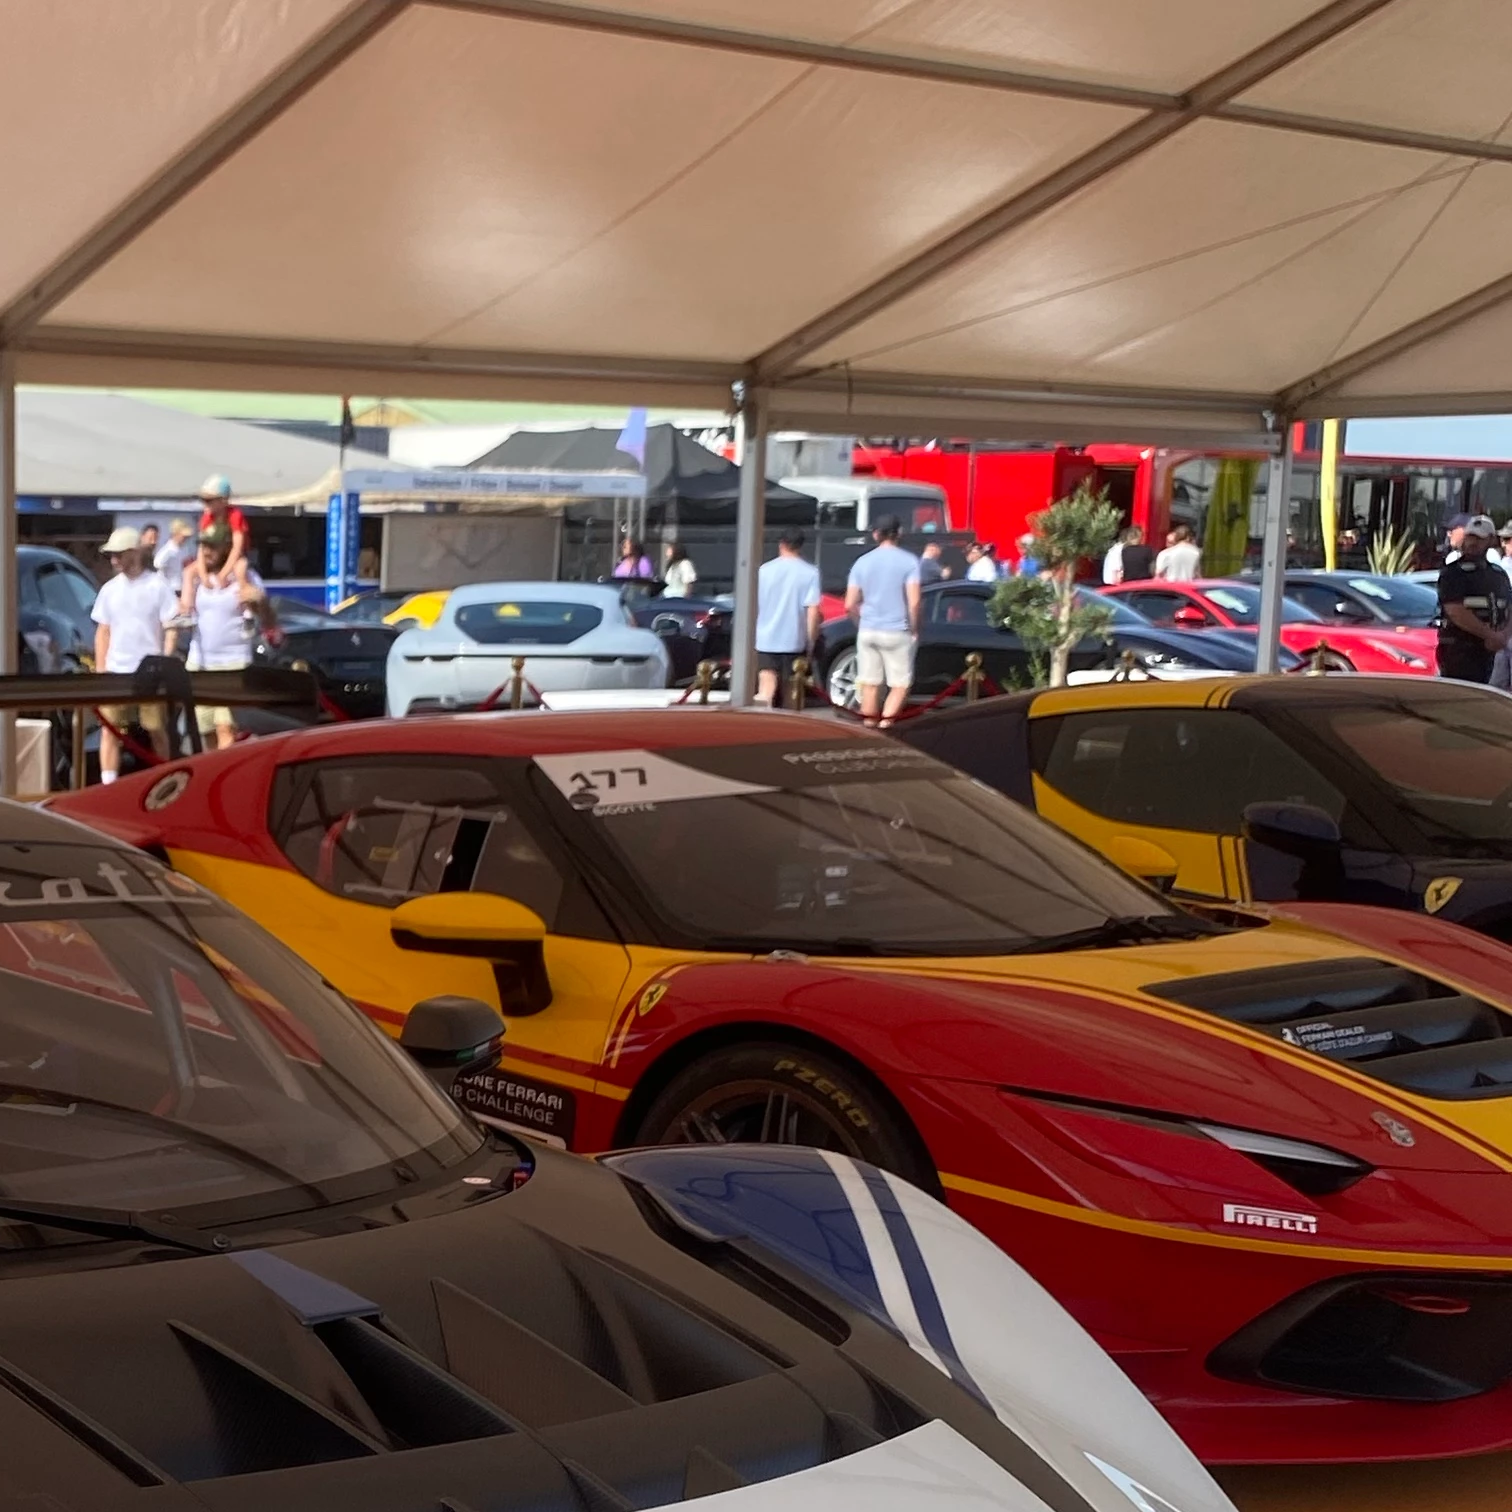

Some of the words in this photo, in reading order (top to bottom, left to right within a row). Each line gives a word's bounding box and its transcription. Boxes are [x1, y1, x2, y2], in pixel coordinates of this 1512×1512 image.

[570, 768, 648, 792] 177
[466, 1088, 554, 1125] CHALLENGE
[497, 1080, 563, 1110] FERRARI
[1223, 1203, 1317, 1233] PIRELLI
